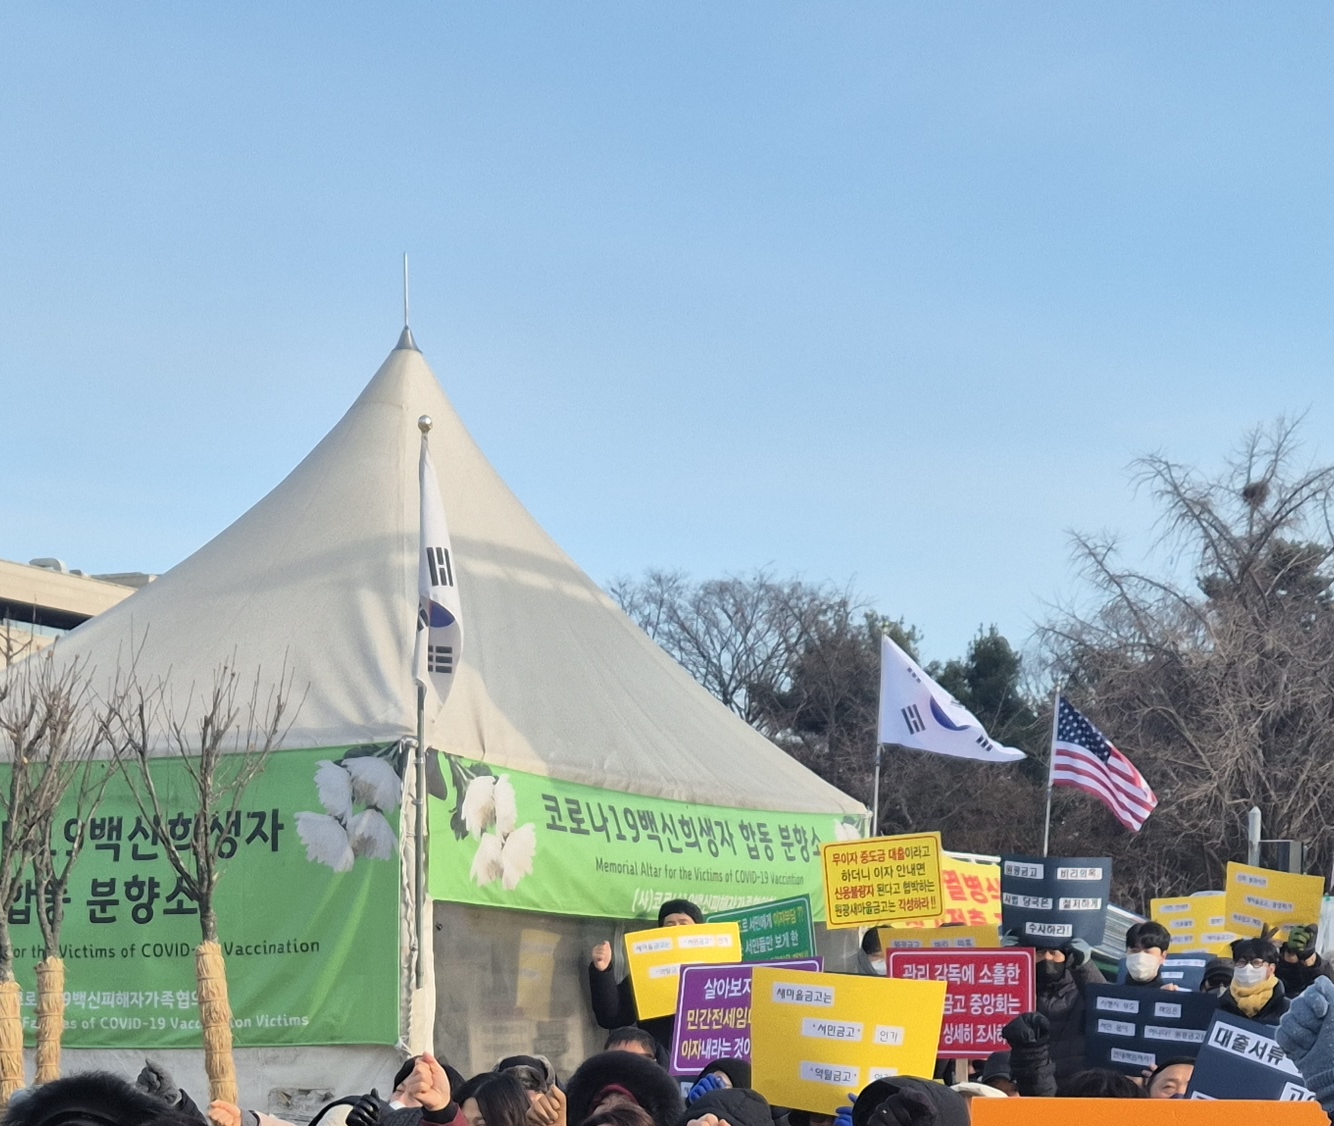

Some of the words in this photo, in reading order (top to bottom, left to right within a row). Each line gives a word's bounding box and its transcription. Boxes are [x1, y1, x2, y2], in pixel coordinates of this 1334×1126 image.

[541, 793, 737, 858] 코로나19백신희생자
[738, 818, 775, 862] 합동
[778, 824, 822, 863] 분향소
[832, 851, 858, 866] 무이자
[860, 849, 886, 864] 중도금
[888, 845, 931, 862] 대출이라고
[595, 856, 638, 876] Memorial
[640, 861, 662, 879] Altar
[665, 866, 678, 880] for
[679, 866, 692, 881] the
[694, 867, 723, 883] Victims
[725, 869, 733, 883] of
[735, 869, 769, 885] COVID-19
[841, 867, 871, 883] 하더니
[874, 865, 894, 880] 이자
[896, 861, 926, 878] 안내면
[86, 874, 198, 925] 분향소
[834, 884, 875, 901] 신용불량자
[876, 882, 901, 897] 된다고
[903, 879, 936, 895] 협박하는
[834, 899, 896, 918] 원광새마을금고는
[898, 896, 930, 912] 각성하라
[59, 943, 116, 959] Victims
[121, 942, 136, 959] of
[141, 942, 197, 958] COVID-
[224, 938, 320, 957] Vaccination
[934, 962, 975, 985] 감독에
[978, 962, 1021, 985] 소홀한
[776, 986, 833, 1004] 새마을금고는
[969, 992, 1021, 1015] 중앙회는
[82, 1016, 95, 1030] of
[99, 1016, 166, 1030] COVID-19
[256, 1013, 309, 1029] Victims
[686, 1006, 752, 1031] 민간전세임
[943, 1022, 974, 1045] 상세히
[681, 1037, 732, 1060] 이자내라는
[1214, 1026, 1286, 1066] 대출서류
